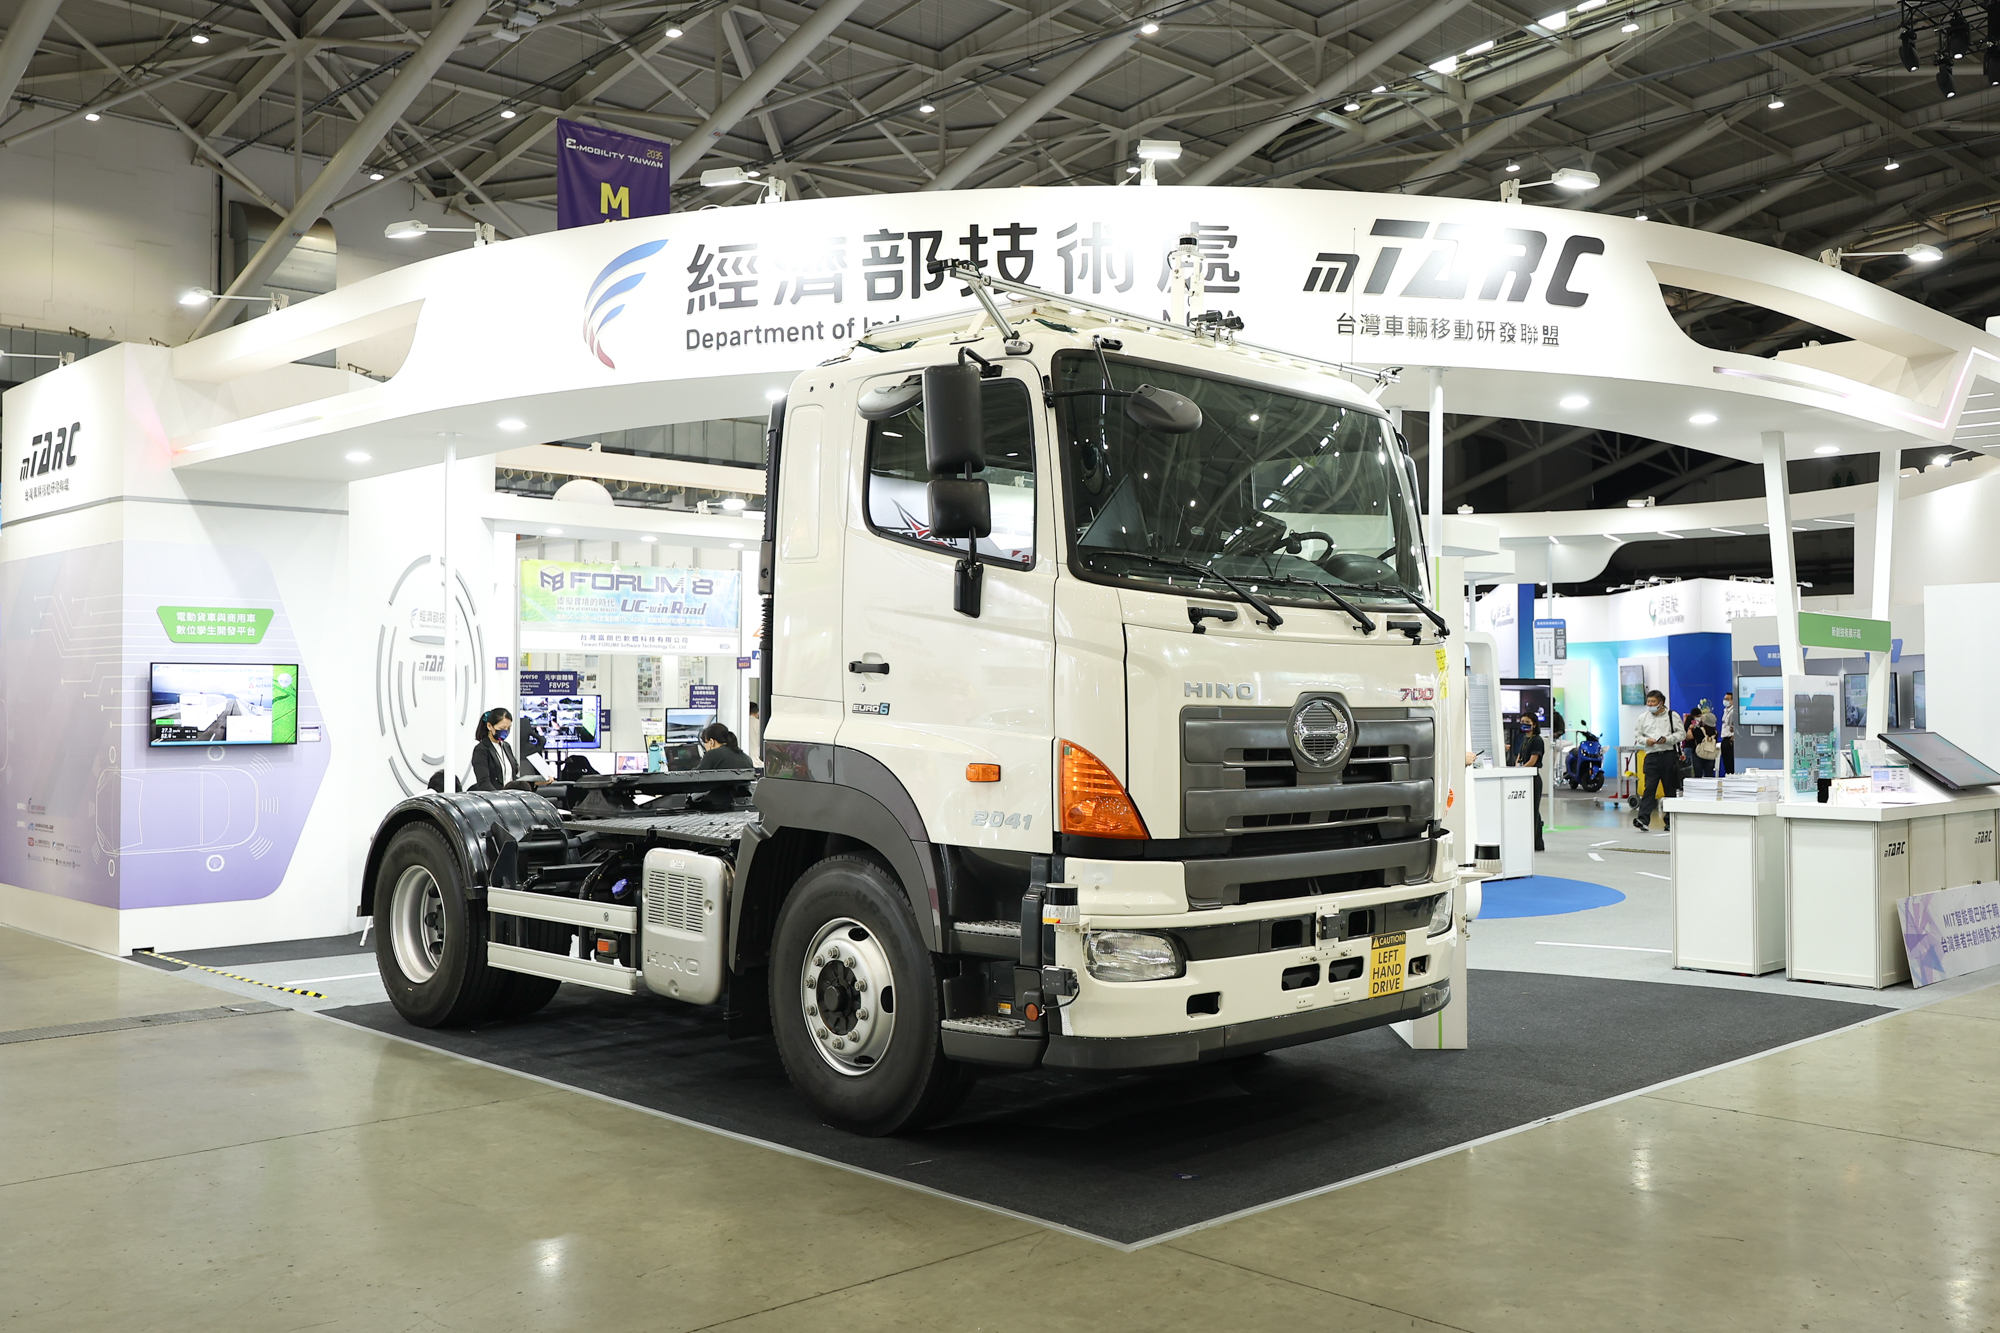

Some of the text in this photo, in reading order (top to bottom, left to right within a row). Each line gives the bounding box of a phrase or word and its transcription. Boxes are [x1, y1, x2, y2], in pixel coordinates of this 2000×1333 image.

[627, 155, 663, 169] TAIWAN
[647, 149, 663, 161] 2035
[601, 182, 629, 218] M
[686, 320, 824, 350] Department
[833, 318, 855, 339] of
[1336, 312, 1560, 347] 台灣車輛移動研發聯盟
[20, 422, 80, 481] mTARC
[176, 612, 256, 624] 電動貨車與商用車
[176, 625, 256, 636] 數位孿生開發平台
[419, 654, 445, 672] mTAR
[548, 681, 570, 689] F8VPS
[1184, 681, 1254, 700] HINO
[1398, 688, 1434, 701] 700
[971, 810, 1032, 830] 2041
[1379, 934, 1406, 946] CAUTION!
[647, 950, 700, 976] HINO
[1378, 949, 1399, 964] LEFT
[1373, 963, 1402, 980] HAND
[1372, 977, 1400, 994] DRIVE
